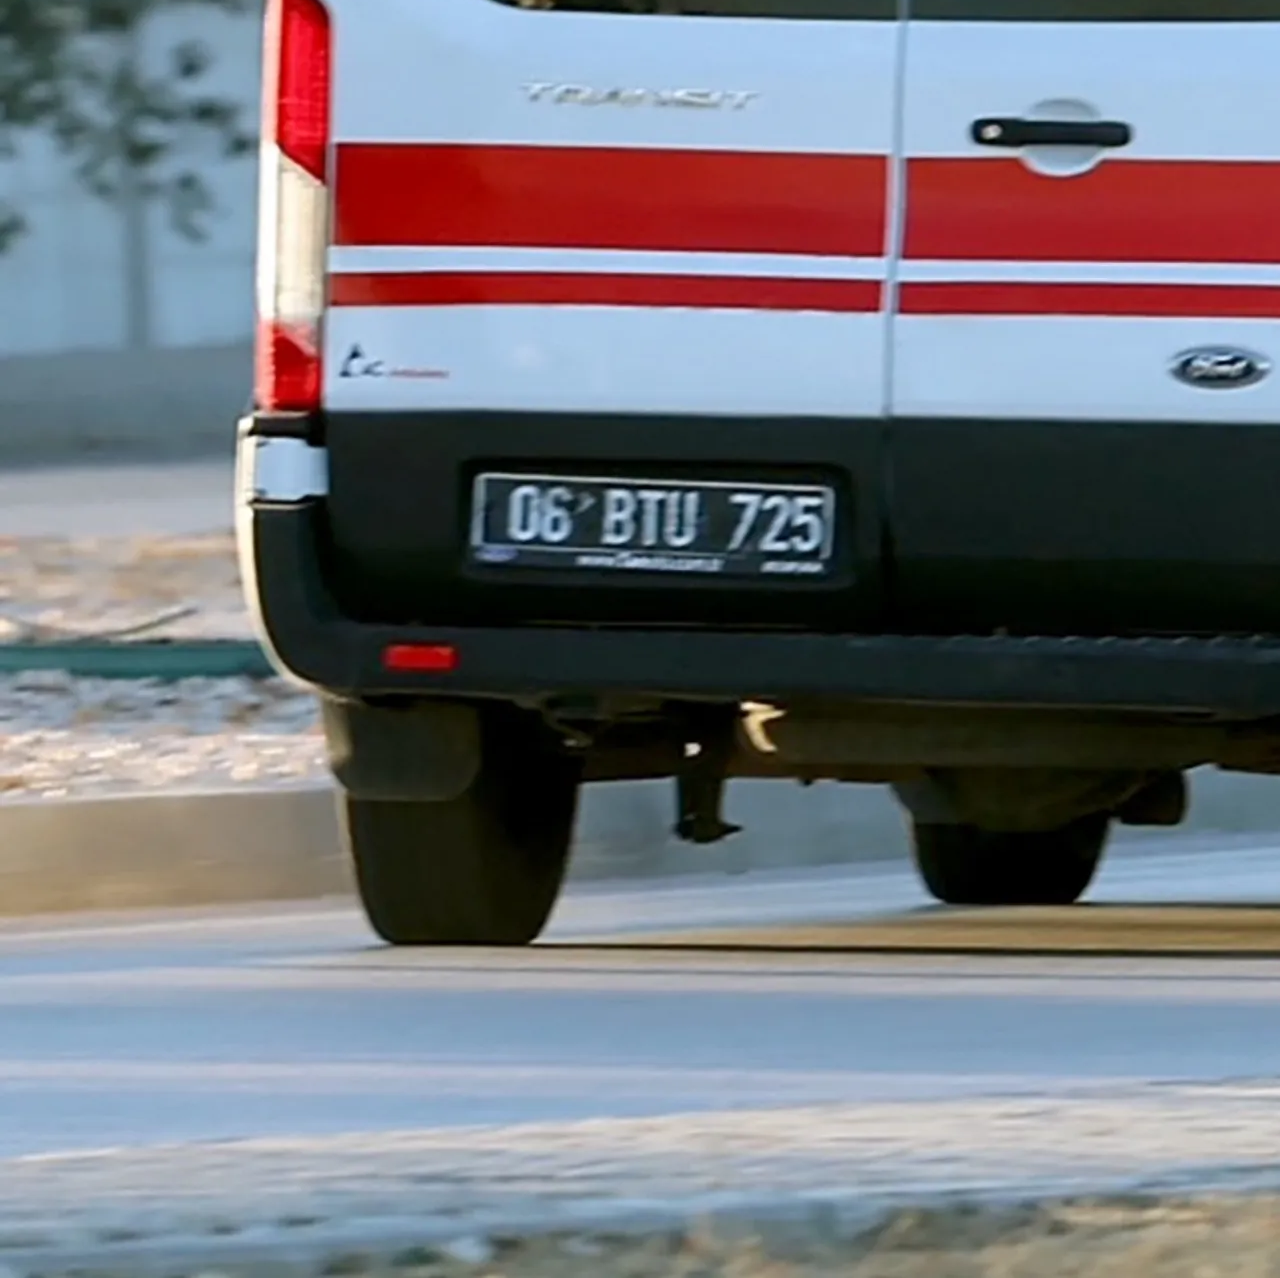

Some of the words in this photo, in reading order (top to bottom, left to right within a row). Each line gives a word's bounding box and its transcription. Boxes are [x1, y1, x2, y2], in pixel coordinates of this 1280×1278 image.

[507, 484, 574, 542] 06
[600, 488, 702, 548] BTU
[727, 493, 826, 553] 725
